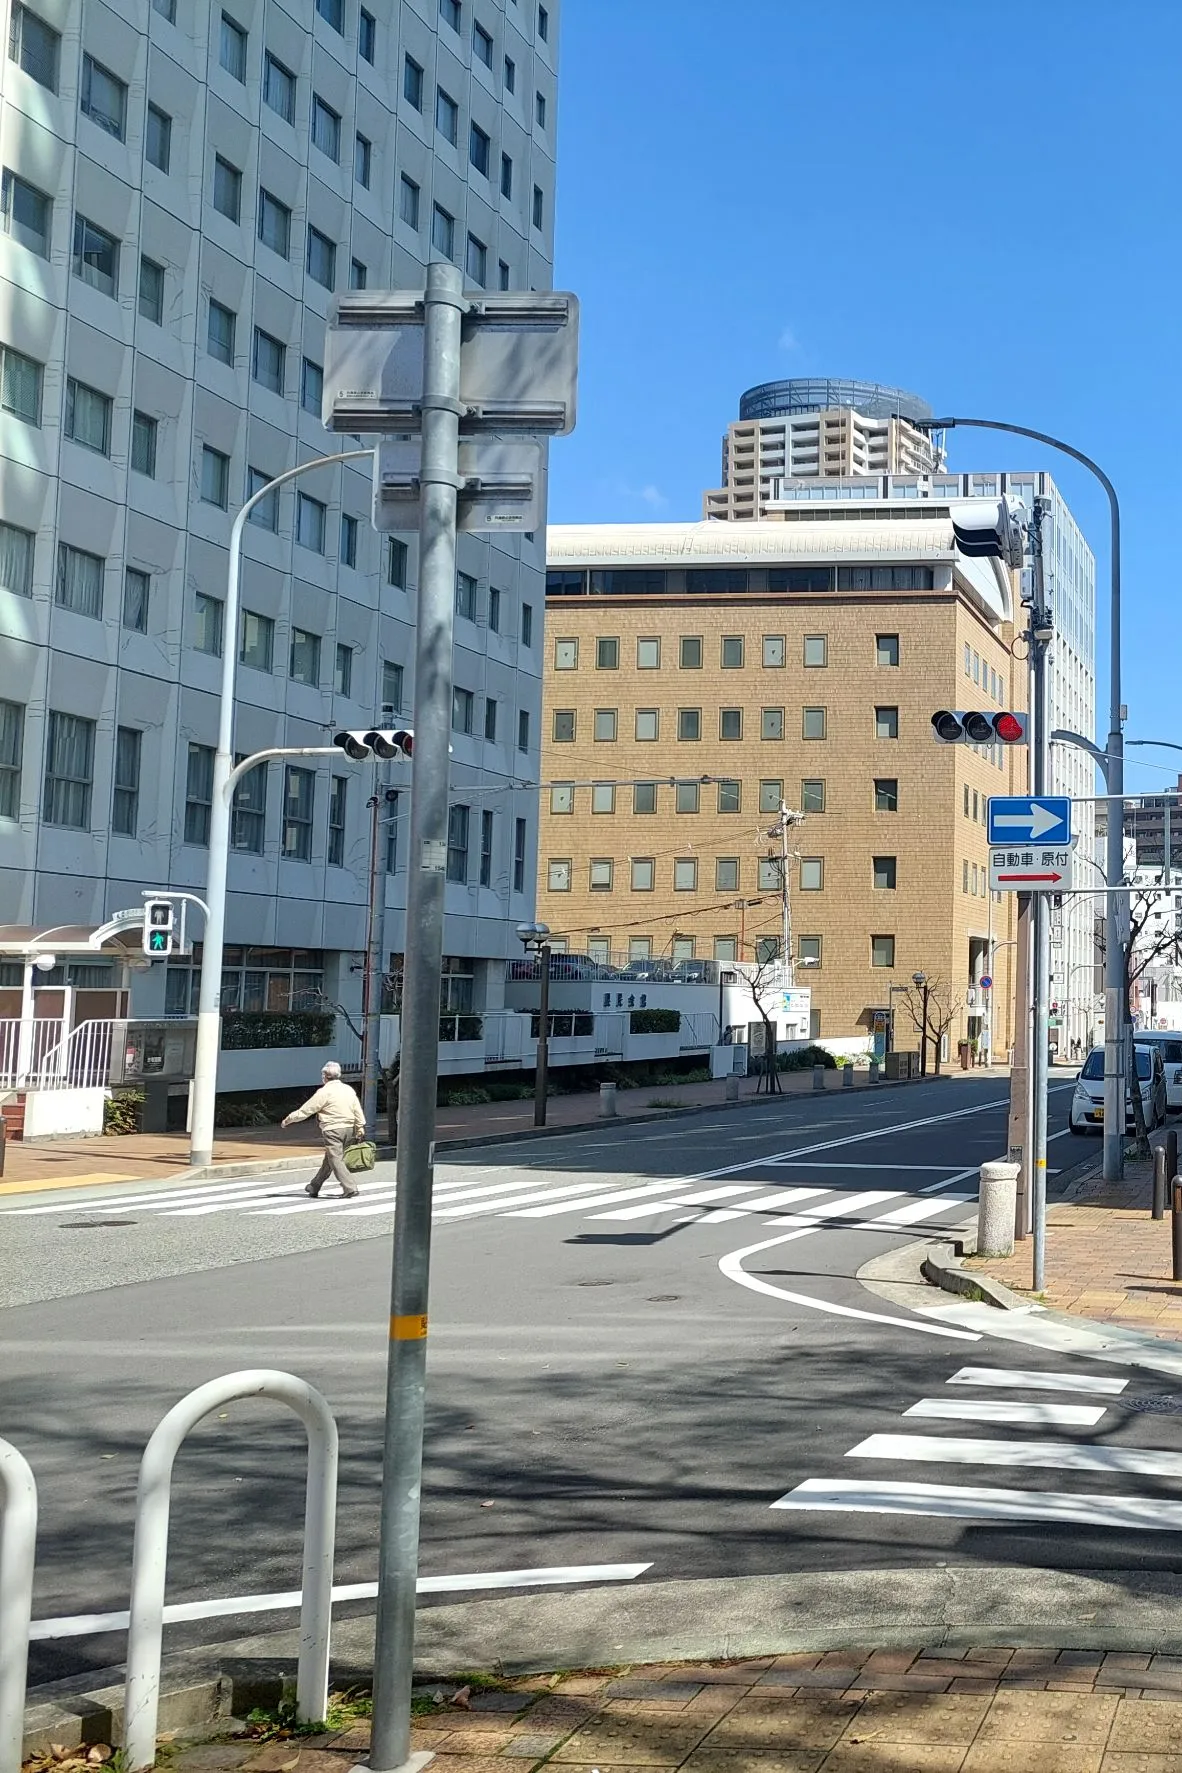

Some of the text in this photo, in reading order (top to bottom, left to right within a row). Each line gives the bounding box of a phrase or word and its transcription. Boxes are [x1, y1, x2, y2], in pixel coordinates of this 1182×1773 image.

[993, 851, 1069, 867] 自動車・原付
